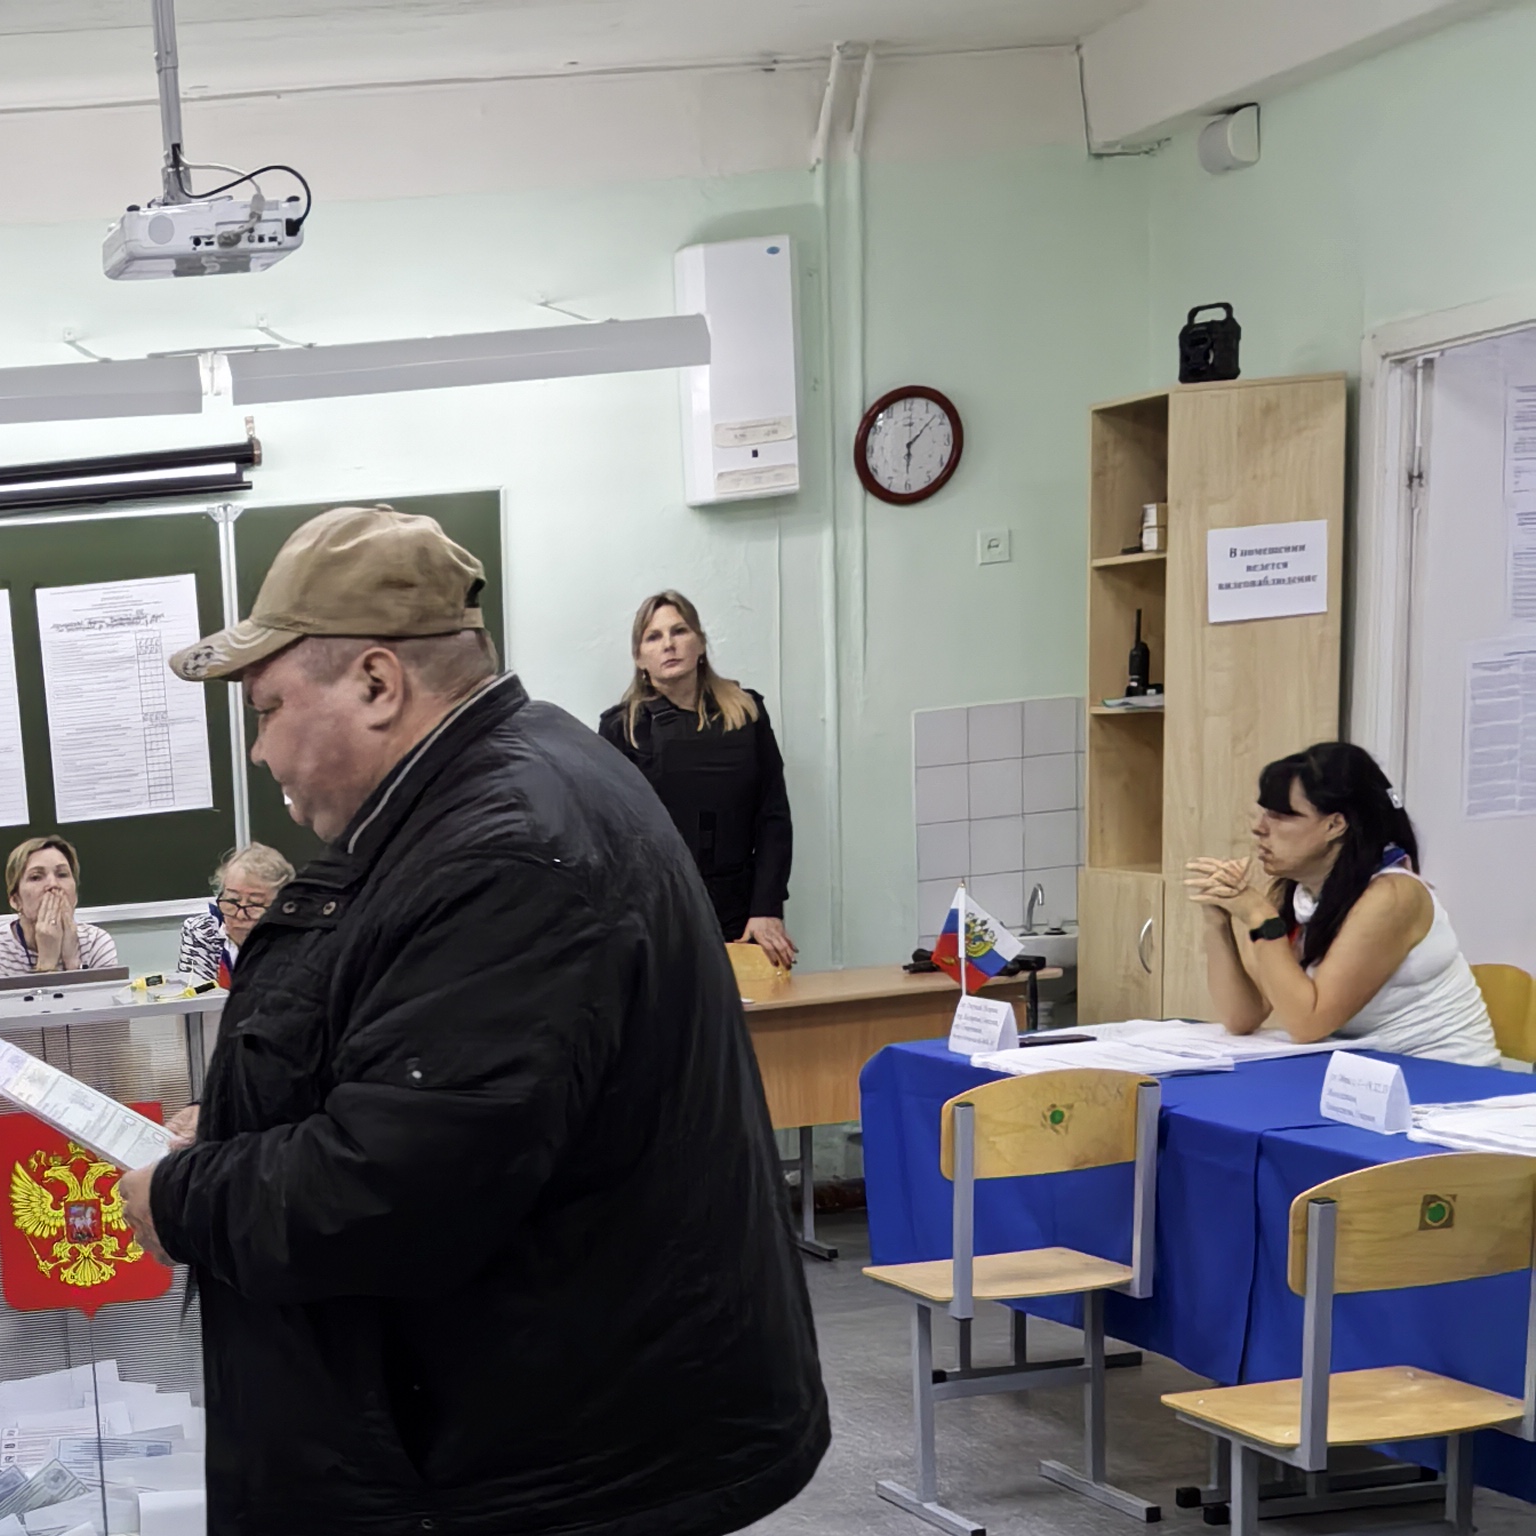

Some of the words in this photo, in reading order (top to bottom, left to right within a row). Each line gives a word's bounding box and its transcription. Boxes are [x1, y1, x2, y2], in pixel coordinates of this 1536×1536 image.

[904, 400, 914, 411] 12
[938, 413, 945, 426] 2
[944, 433, 950, 446] 3
[887, 476, 894, 490] 7
[924, 470, 931, 484] 5
[904, 479, 911, 491] 6
[1229, 547, 1237, 558] В
[1240, 544, 1306, 557] помещении
[1218, 574, 1318, 590] видеонаблюдение
